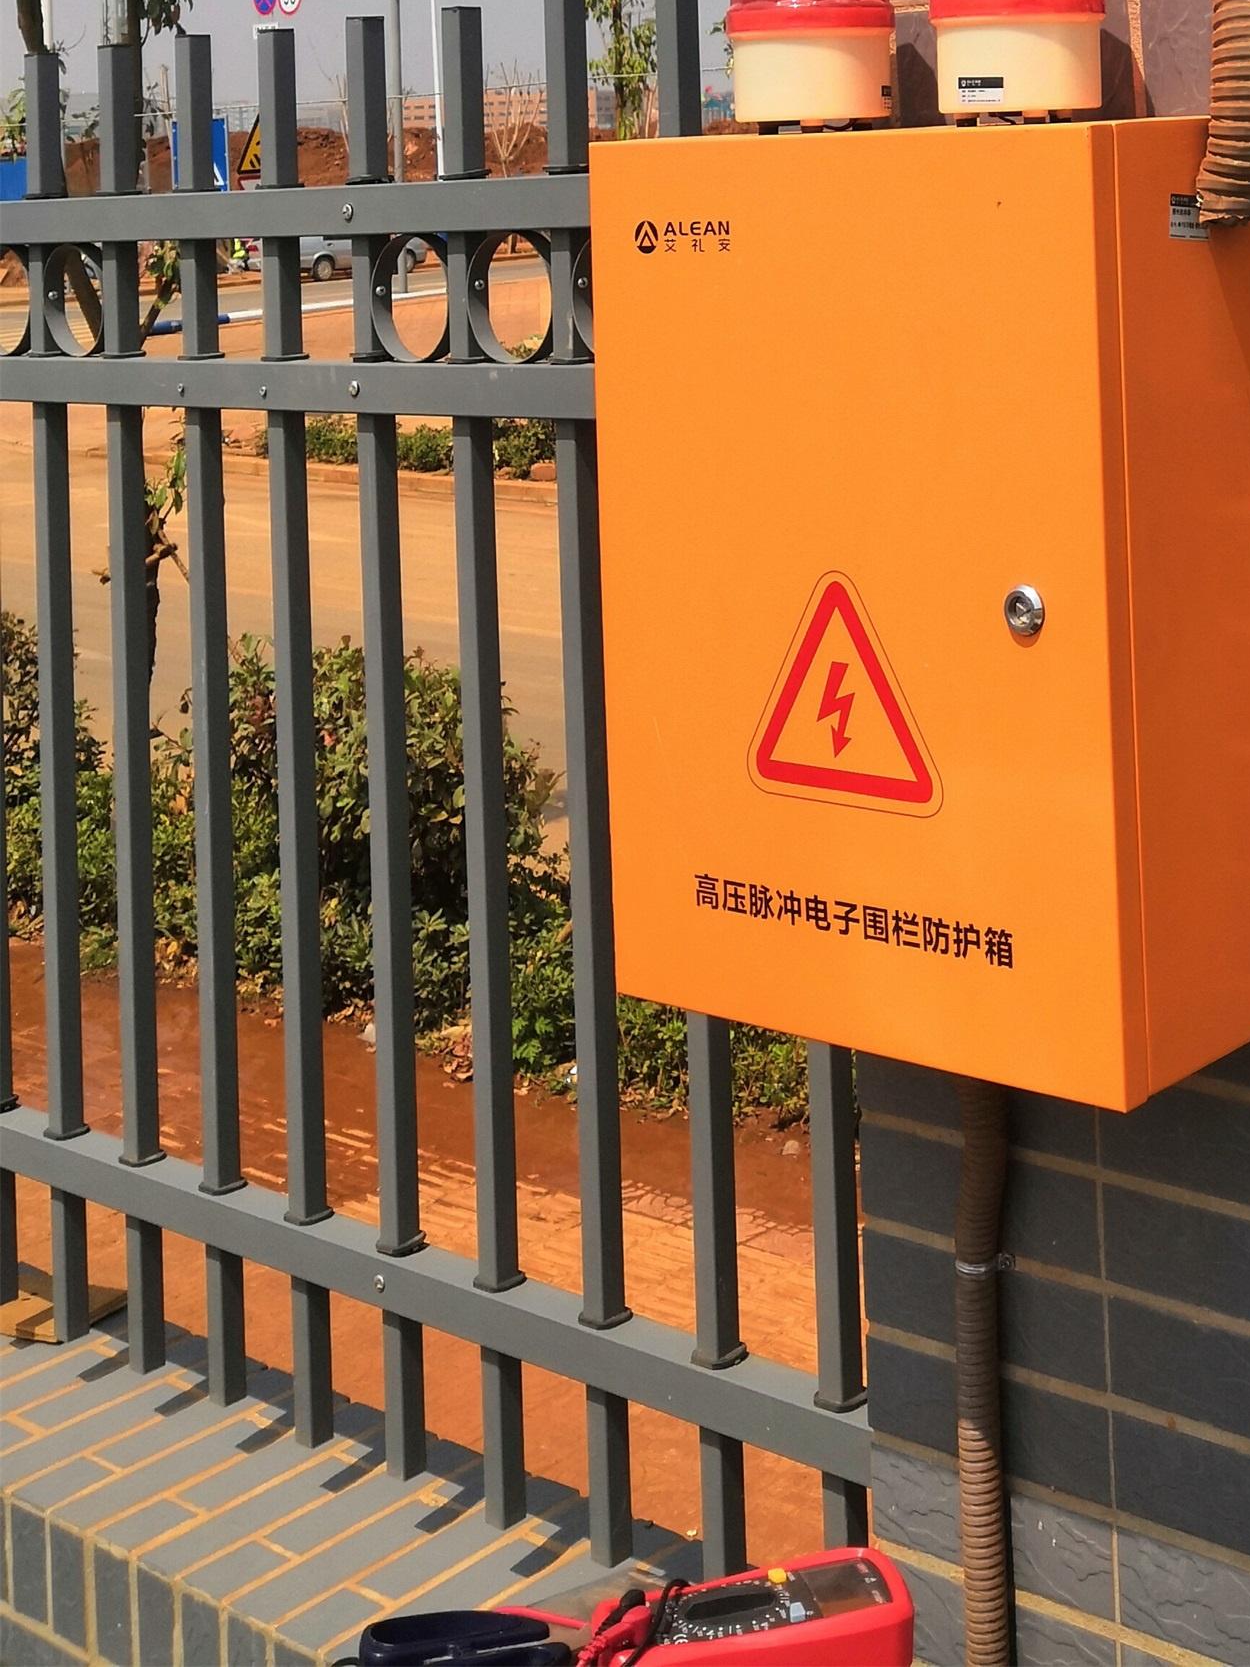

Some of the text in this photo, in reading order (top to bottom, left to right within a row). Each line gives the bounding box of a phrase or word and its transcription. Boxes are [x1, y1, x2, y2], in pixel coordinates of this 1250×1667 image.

[663, 220, 731, 237] ALEAN
[694, 873, 1014, 970] 高压脉冲电子围栏防护箱
